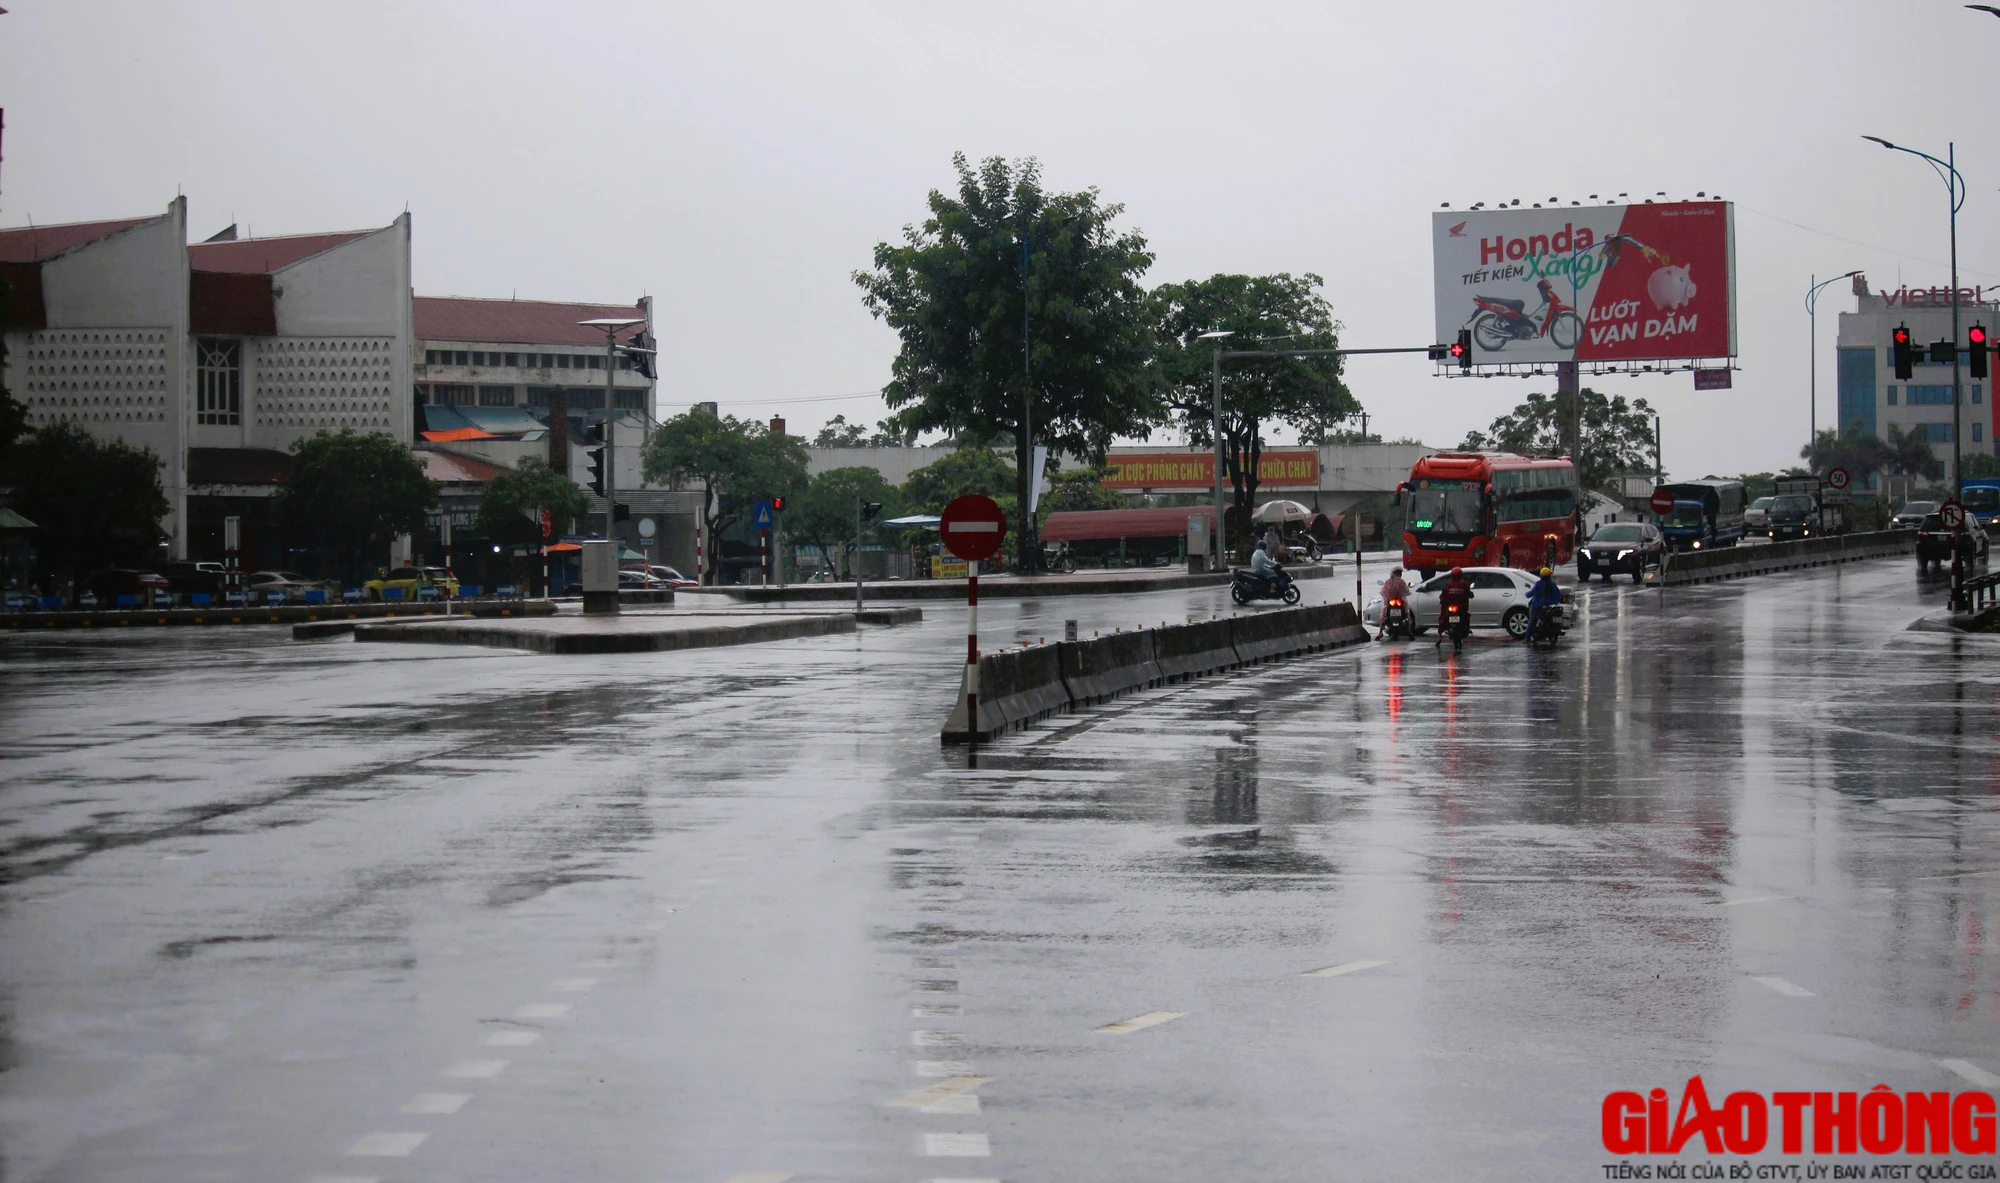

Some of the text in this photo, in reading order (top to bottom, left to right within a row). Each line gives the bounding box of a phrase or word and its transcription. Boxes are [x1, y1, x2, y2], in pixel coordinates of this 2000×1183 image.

[1480, 223, 1594, 265] Honda
[1462, 249, 1603, 290] TIẾT KIỆM Xăng
[1880, 284, 1986, 306] viettel
[1590, 299, 1641, 323] LƯỚT
[1590, 312, 1698, 348] VẠN DẶM
[1126, 461, 1145, 485] CỰC
[1146, 459, 1178, 482] PHÒNG
[1180, 458, 1205, 481] CHÁY
[1261, 457, 1286, 479] CHỮA
[1288, 457, 1312, 479] CHÁY
[1834, 473, 1843, 483] 50
